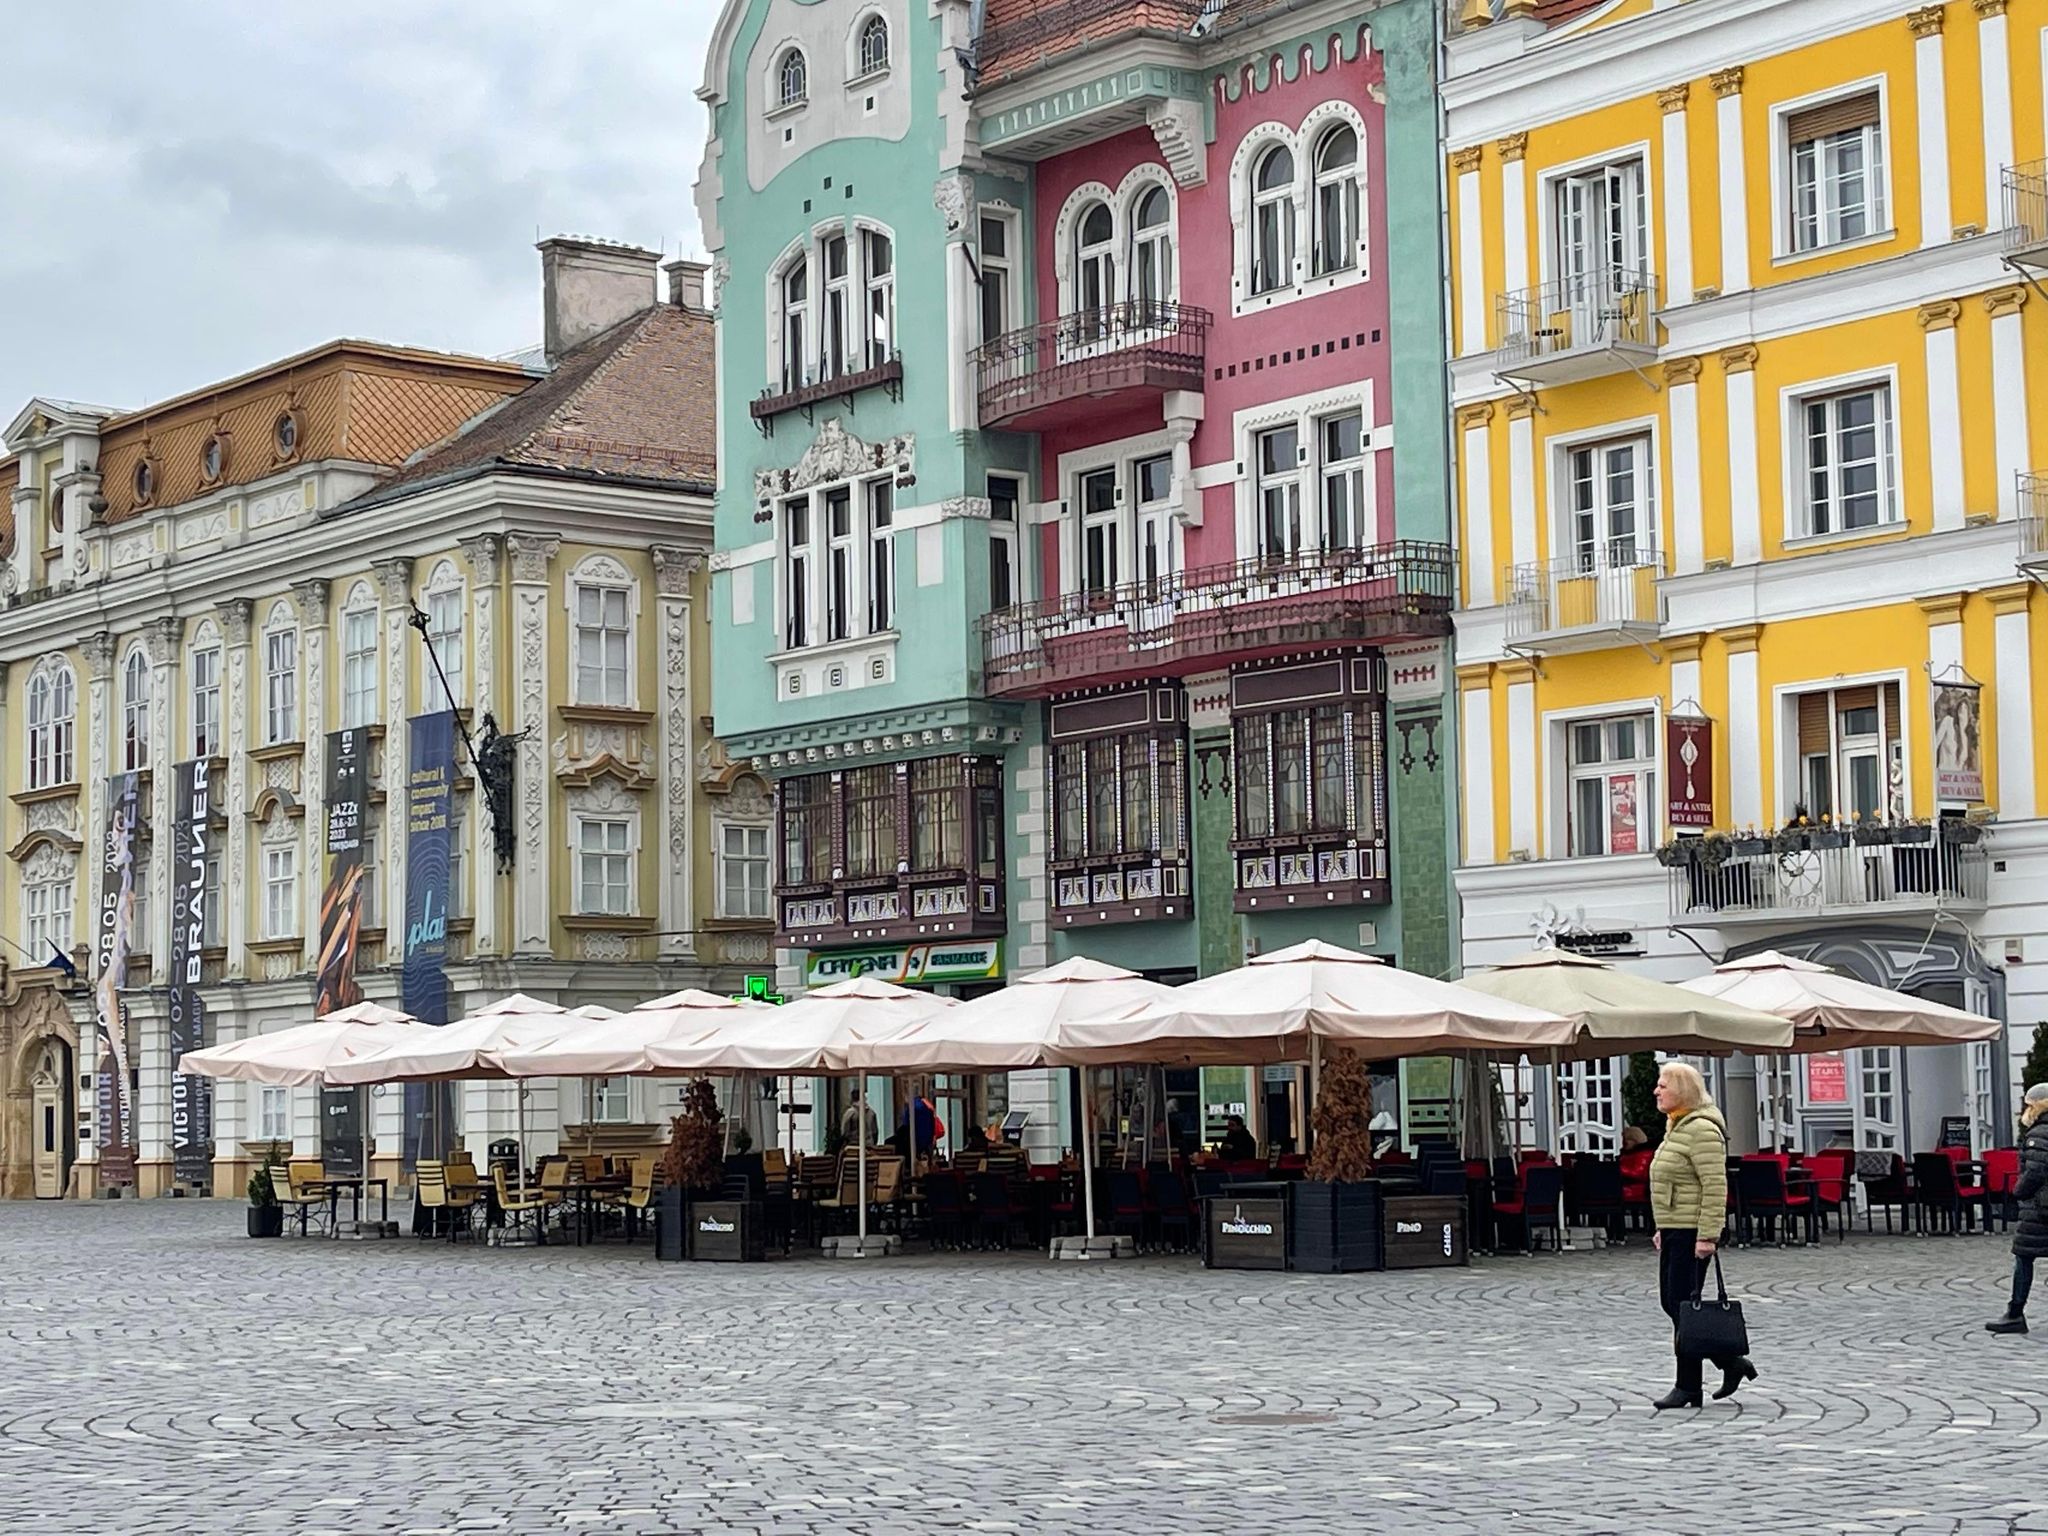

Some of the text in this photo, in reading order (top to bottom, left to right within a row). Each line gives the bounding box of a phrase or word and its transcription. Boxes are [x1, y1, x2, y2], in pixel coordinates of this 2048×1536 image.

[411, 782, 449, 800] community
[410, 820, 430, 832] since
[411, 801, 436, 818] impact
[176, 819, 190, 864] 2023
[407, 890, 445, 957] plai
[99, 1072, 112, 1148] VICTOR
[118, 1073, 131, 1148] INVENTIONS
[173, 1071, 189, 1149] VICTOR
[1221, 1222, 1273, 1235] PINOCCHIO
[1396, 1222, 1422, 1233] PINO
[1443, 1224, 1451, 1257] CHIO
